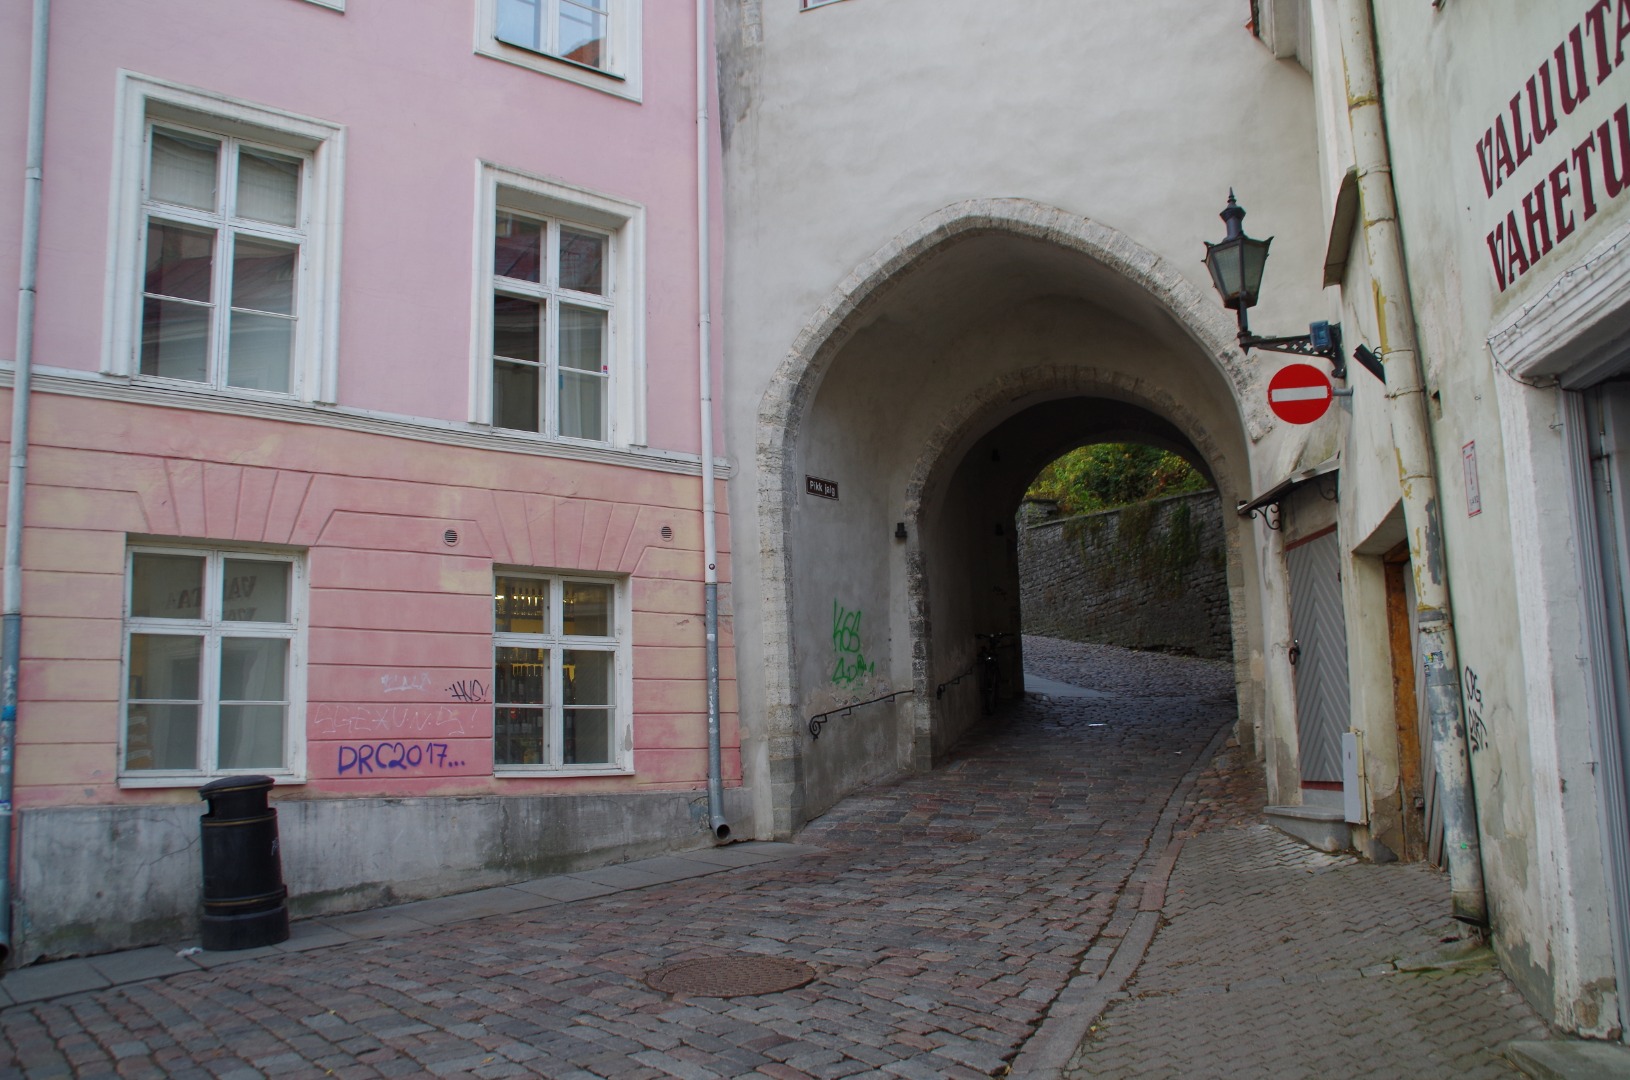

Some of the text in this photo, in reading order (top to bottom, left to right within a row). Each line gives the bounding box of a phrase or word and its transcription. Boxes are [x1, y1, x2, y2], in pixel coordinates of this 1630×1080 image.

[809, 480, 836, 497] Pikk jalg
[338, 742, 466, 775] DRC2017...
